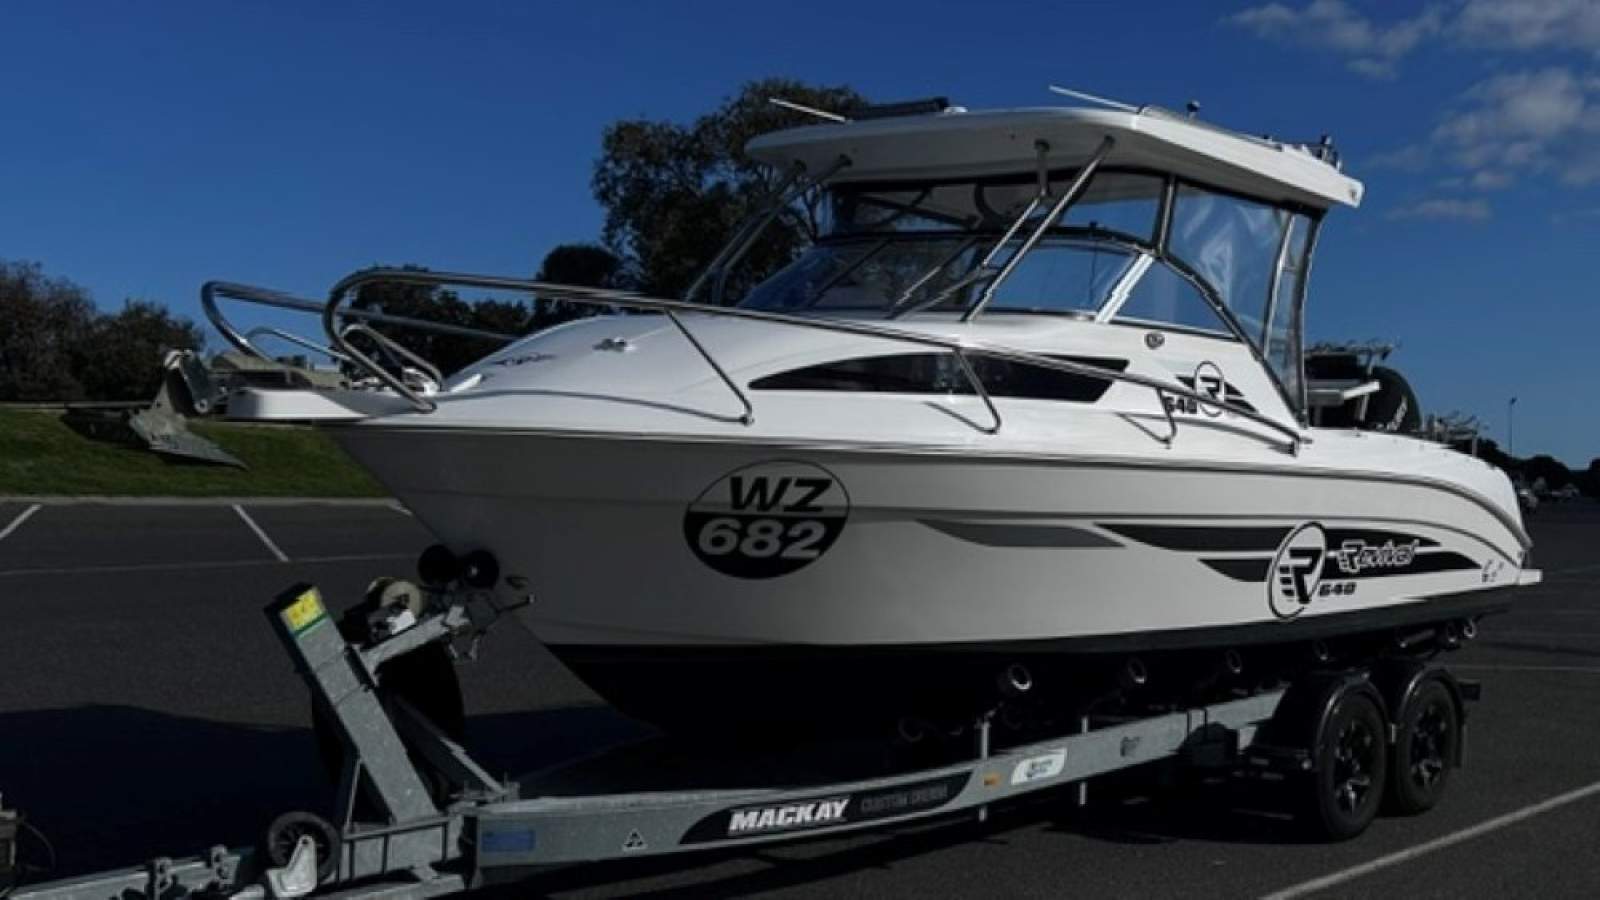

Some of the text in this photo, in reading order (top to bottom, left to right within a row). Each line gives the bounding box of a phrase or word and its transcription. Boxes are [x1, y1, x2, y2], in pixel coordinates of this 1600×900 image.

[729, 476, 833, 512] WZ
[698, 517, 827, 559] 682
[1319, 582, 1357, 597] 640
[728, 798, 851, 831] MACKAY
